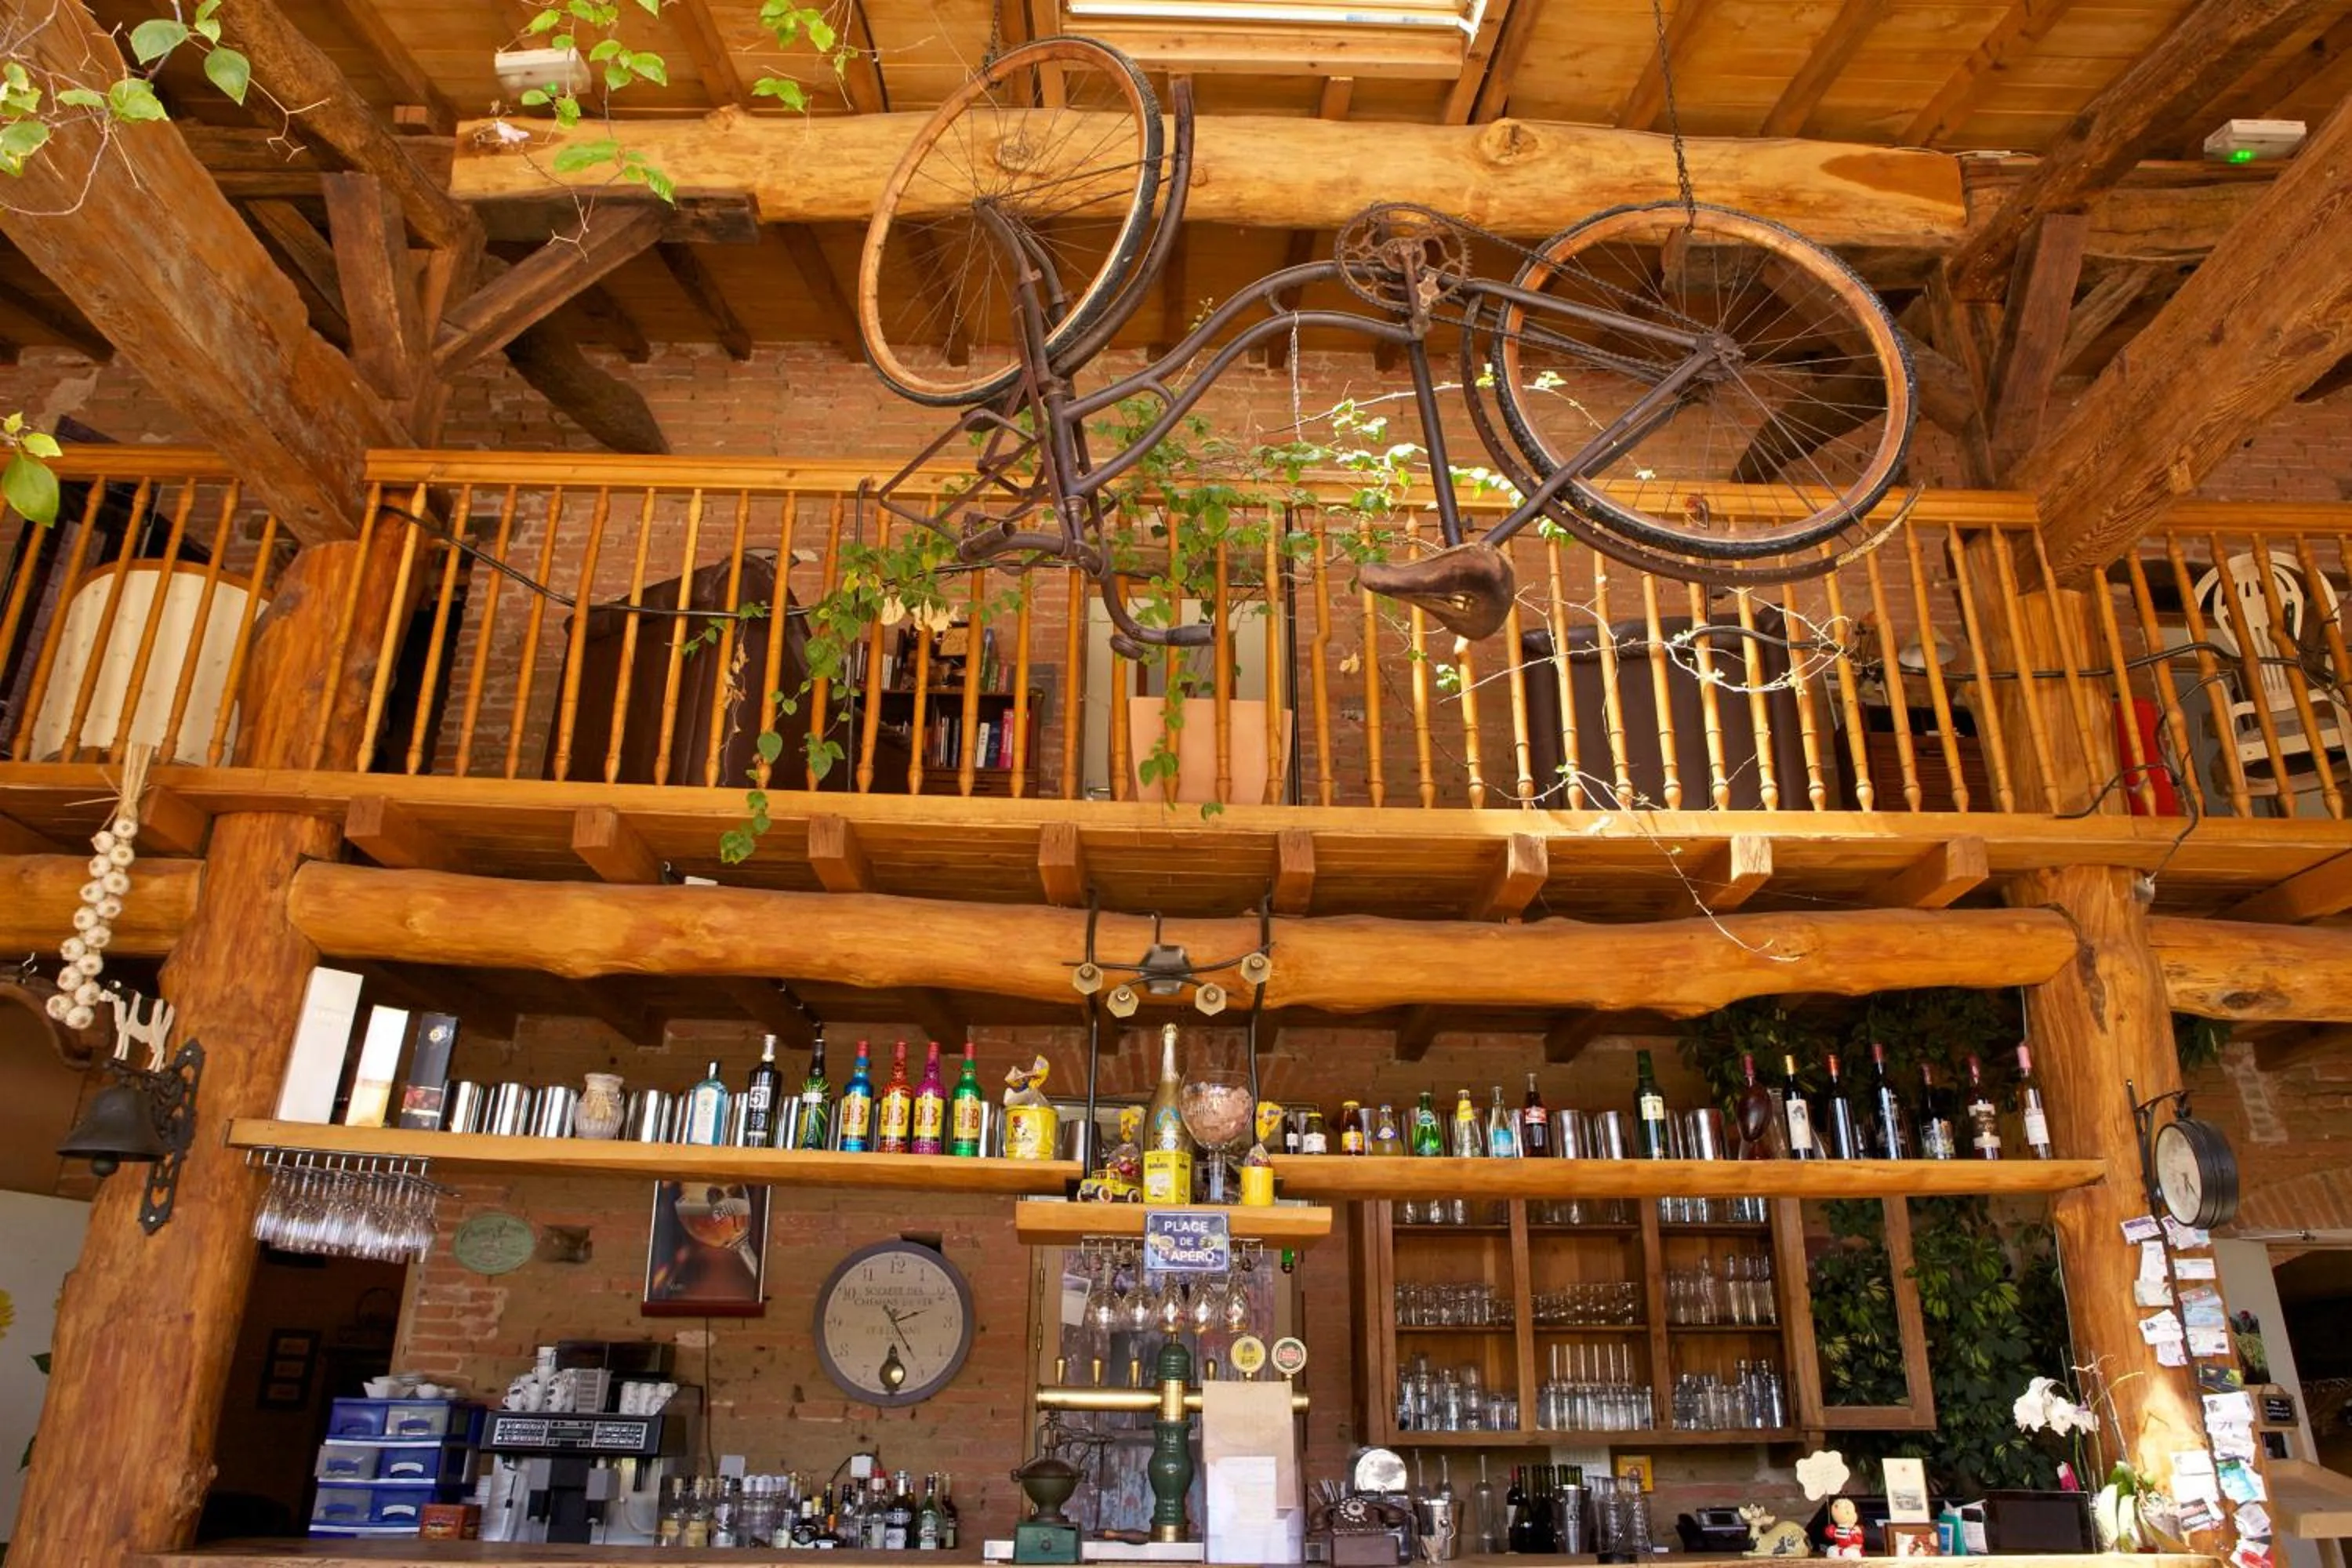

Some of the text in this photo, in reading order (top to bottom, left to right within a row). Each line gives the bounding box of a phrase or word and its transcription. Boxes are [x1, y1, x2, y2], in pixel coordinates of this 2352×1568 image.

[750, 1091, 768, 1105] 51
[1164, 1221, 1210, 1233] PLACE
[1179, 1236, 1194, 1246] DE
[890, 1260, 906, 1274] 12
